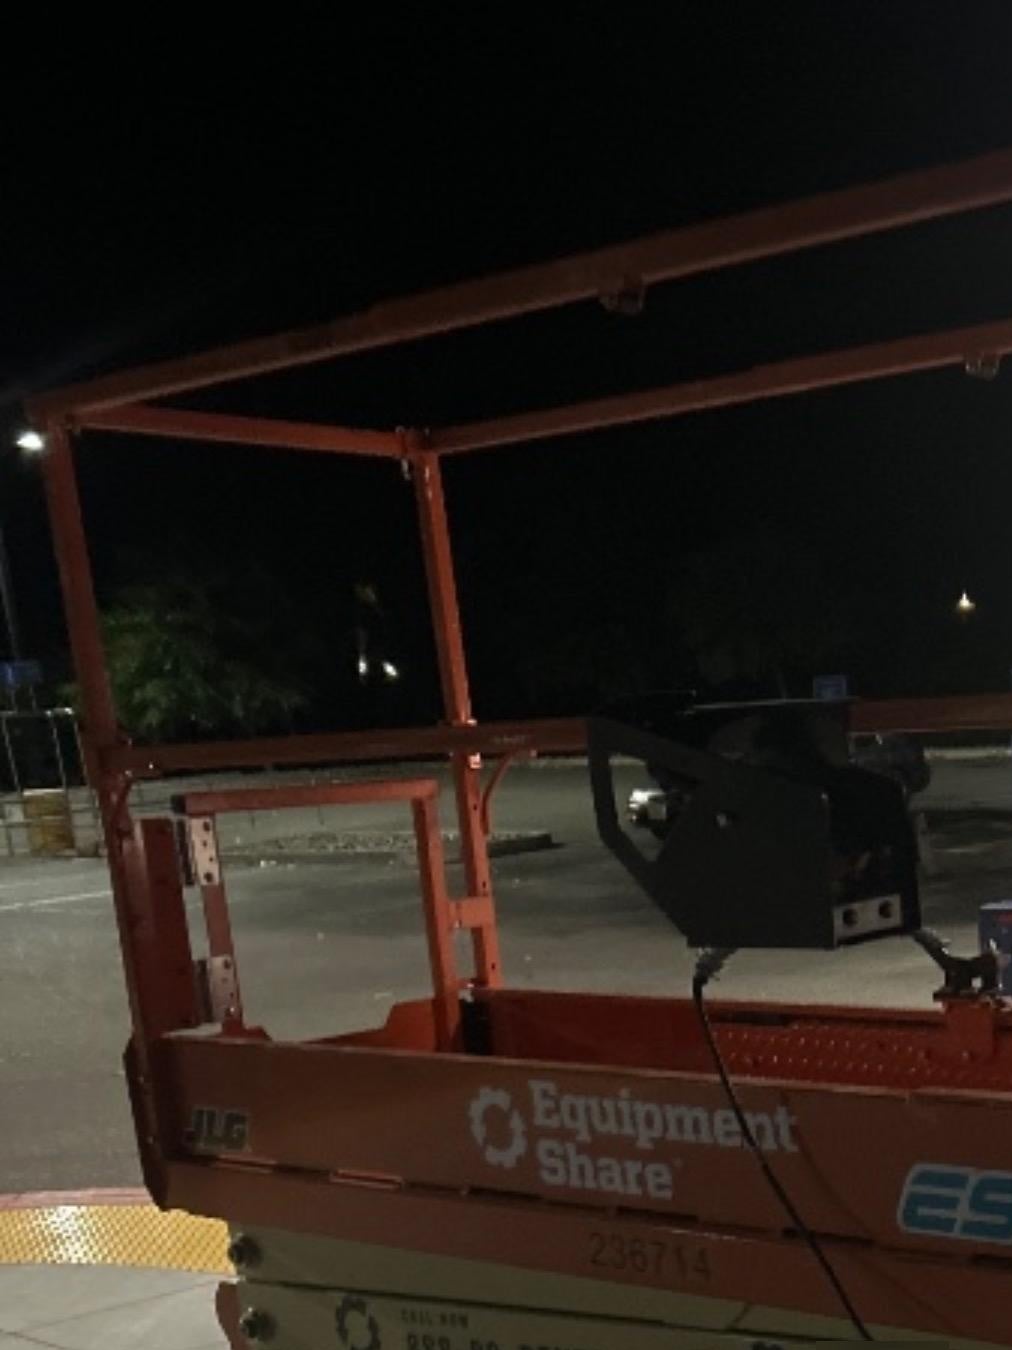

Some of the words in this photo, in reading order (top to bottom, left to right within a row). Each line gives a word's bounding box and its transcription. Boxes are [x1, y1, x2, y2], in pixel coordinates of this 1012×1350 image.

[184, 1109, 248, 1149] JLG
[528, 1079, 799, 1152] Equipment
[536, 1138, 673, 1200] Share
[590, 1231, 711, 1282] 236714
